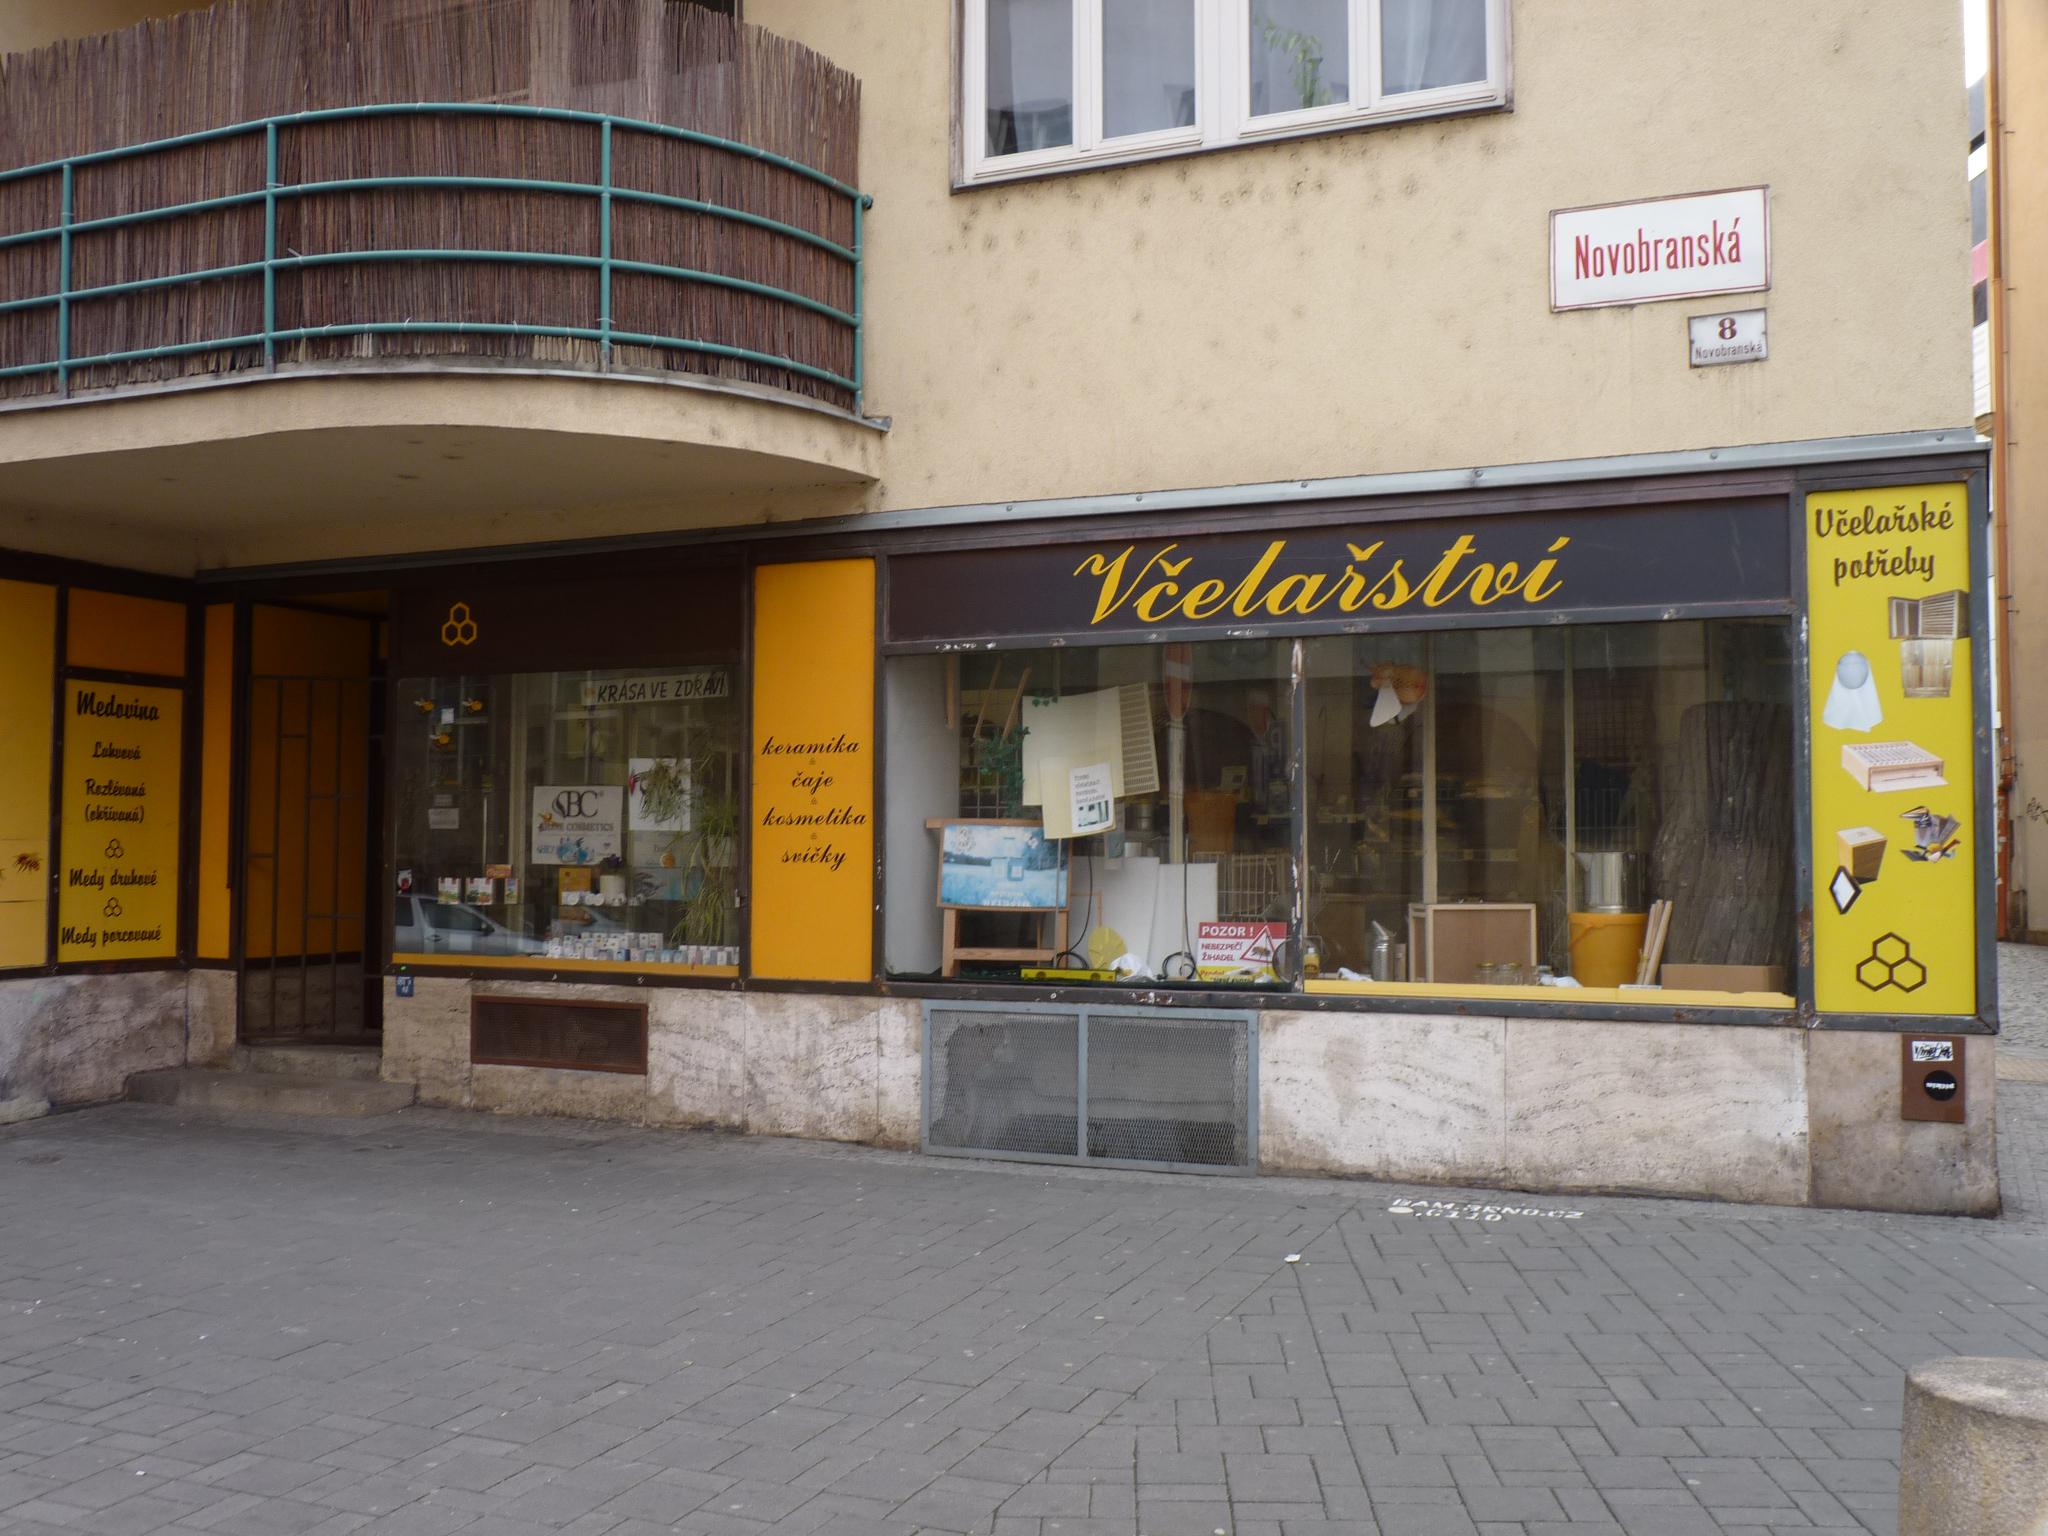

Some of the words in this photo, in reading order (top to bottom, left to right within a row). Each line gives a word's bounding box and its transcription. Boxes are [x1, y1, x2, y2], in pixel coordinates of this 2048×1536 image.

[1575, 217, 1742, 280] Novobranská
[1718, 317, 1737, 340] 8
[1695, 340, 1762, 360] Novobranská
[1814, 500, 1954, 540] Včelařské
[1834, 545, 1935, 587] potřeby
[1072, 534, 1571, 625] Včelařství
[598, 680, 646, 703] KRÁSA
[651, 681, 668, 698] VE
[77, 690, 160, 721] Medovina
[92, 741, 142, 760] Lahvová
[761, 734, 860, 756] keramika
[85, 778, 146, 797] Rozlévaná
[791, 771, 834, 794] čaje
[761, 806, 866, 827] kosmetika
[781, 844, 848, 872] svíčky
[69, 868, 104, 891] Medy
[110, 869, 158, 887] druhové
[61, 926, 97, 948] Medy
[103, 924, 162, 947] porcované
[1201, 926, 1246, 937] POZOR
[1200, 941, 1243, 951] NEBEZPEČÍ
[1201, 952, 1235, 961] ŽIHADEL
